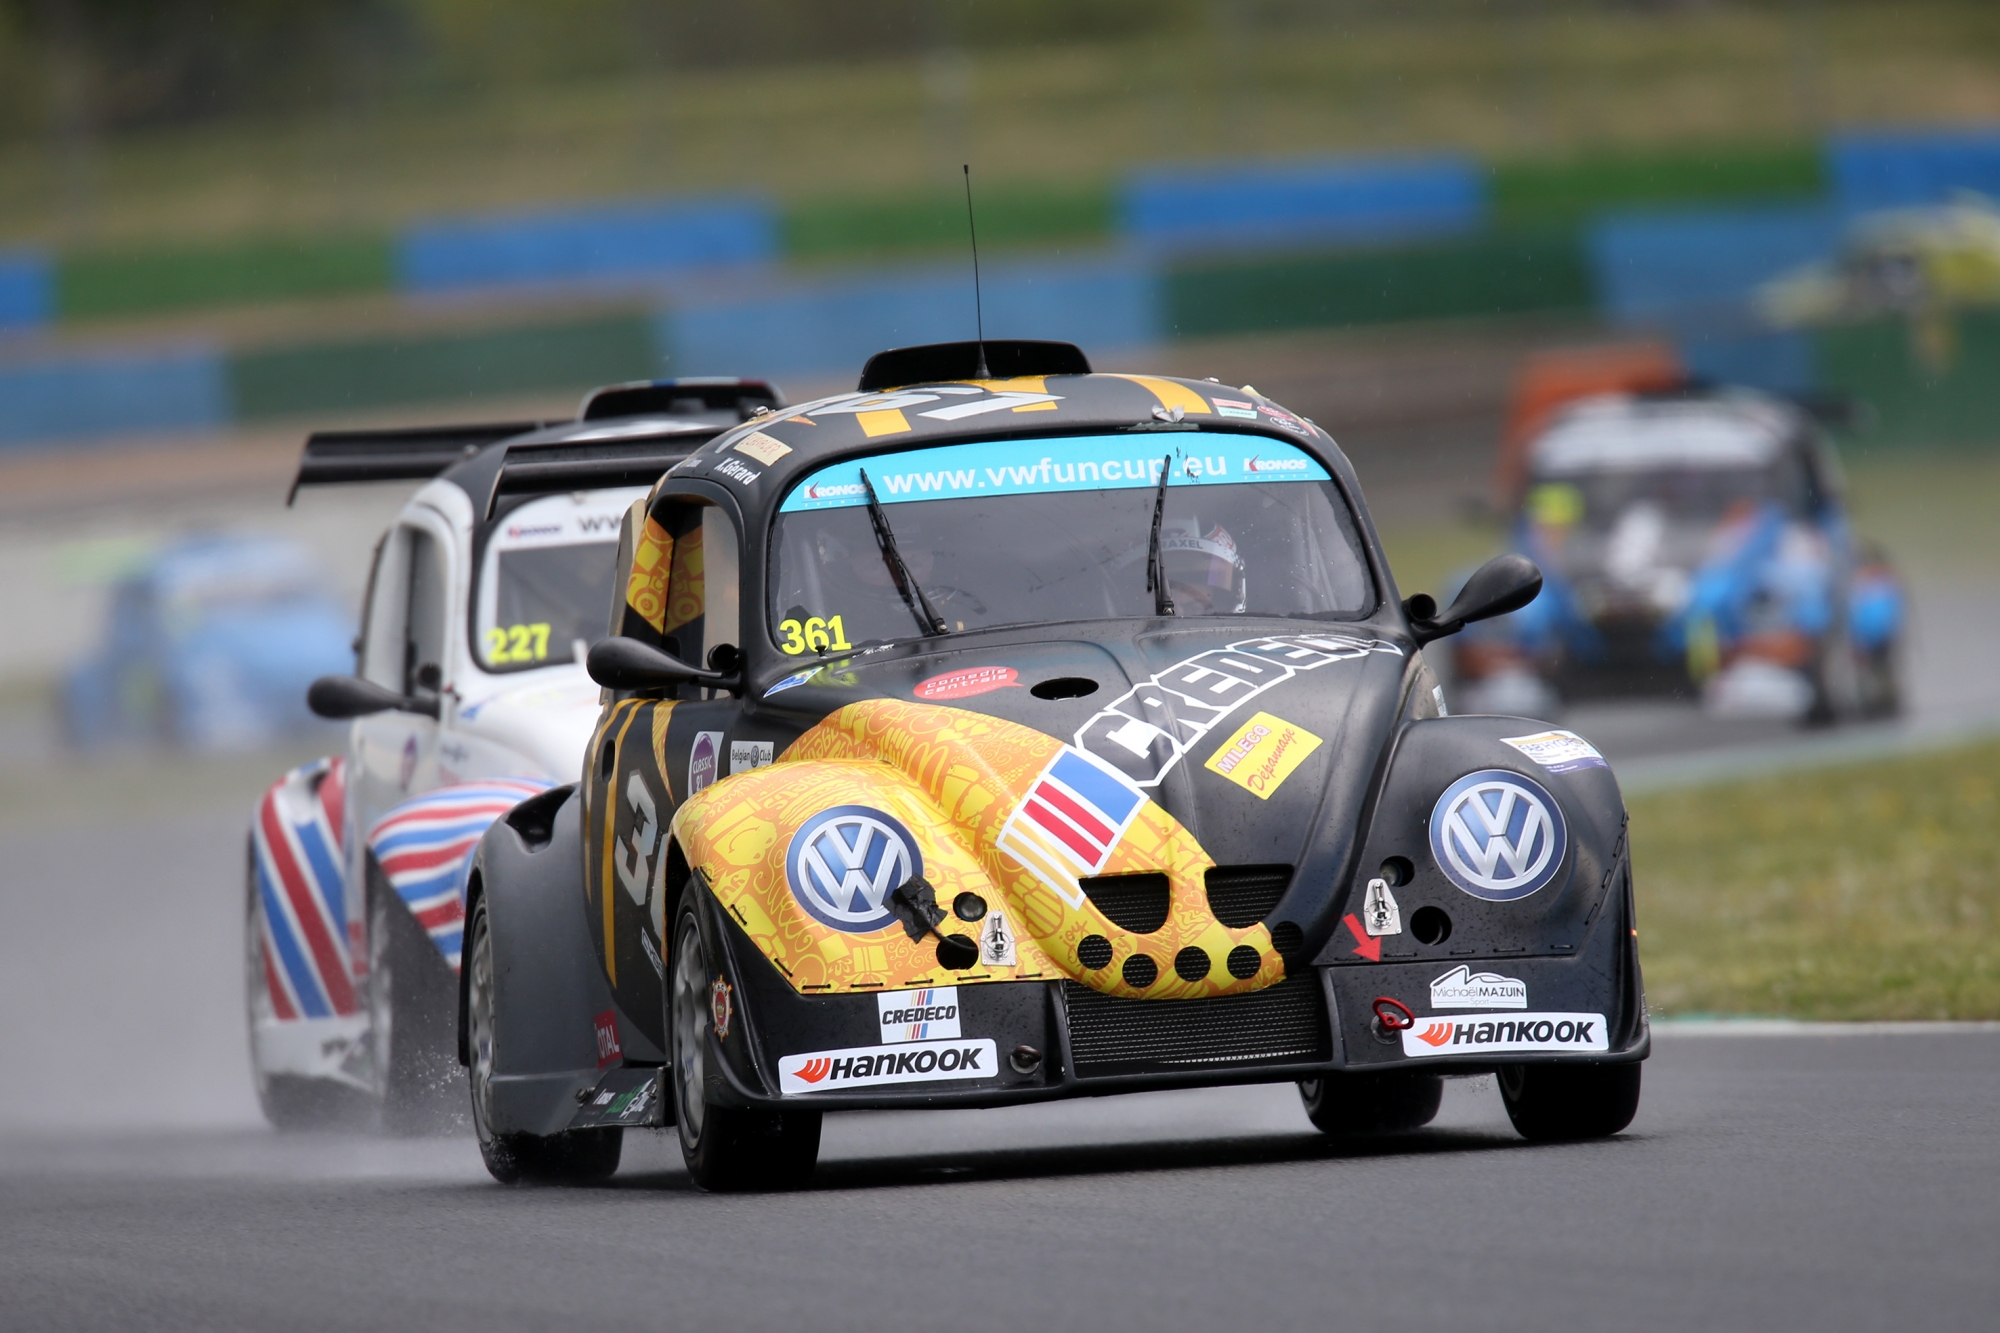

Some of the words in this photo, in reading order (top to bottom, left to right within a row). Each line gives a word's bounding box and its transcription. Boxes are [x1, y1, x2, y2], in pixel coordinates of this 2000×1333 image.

[883, 455, 1227, 494] www.vwfuncup.eu
[1243, 454, 1308, 472] KRONOS
[803, 481, 868, 499] KRONOS
[486, 622, 551, 664] 227
[780, 614, 852, 656] 361
[732, 749, 751, 763] Belgian
[760, 749, 772, 762] Club
[1215, 724, 1272, 774] MILECQ
[1247, 728, 1298, 792] Dépannage
[692, 755, 713, 774] CLASSIC
[882, 1006, 957, 1025] CREDECO
